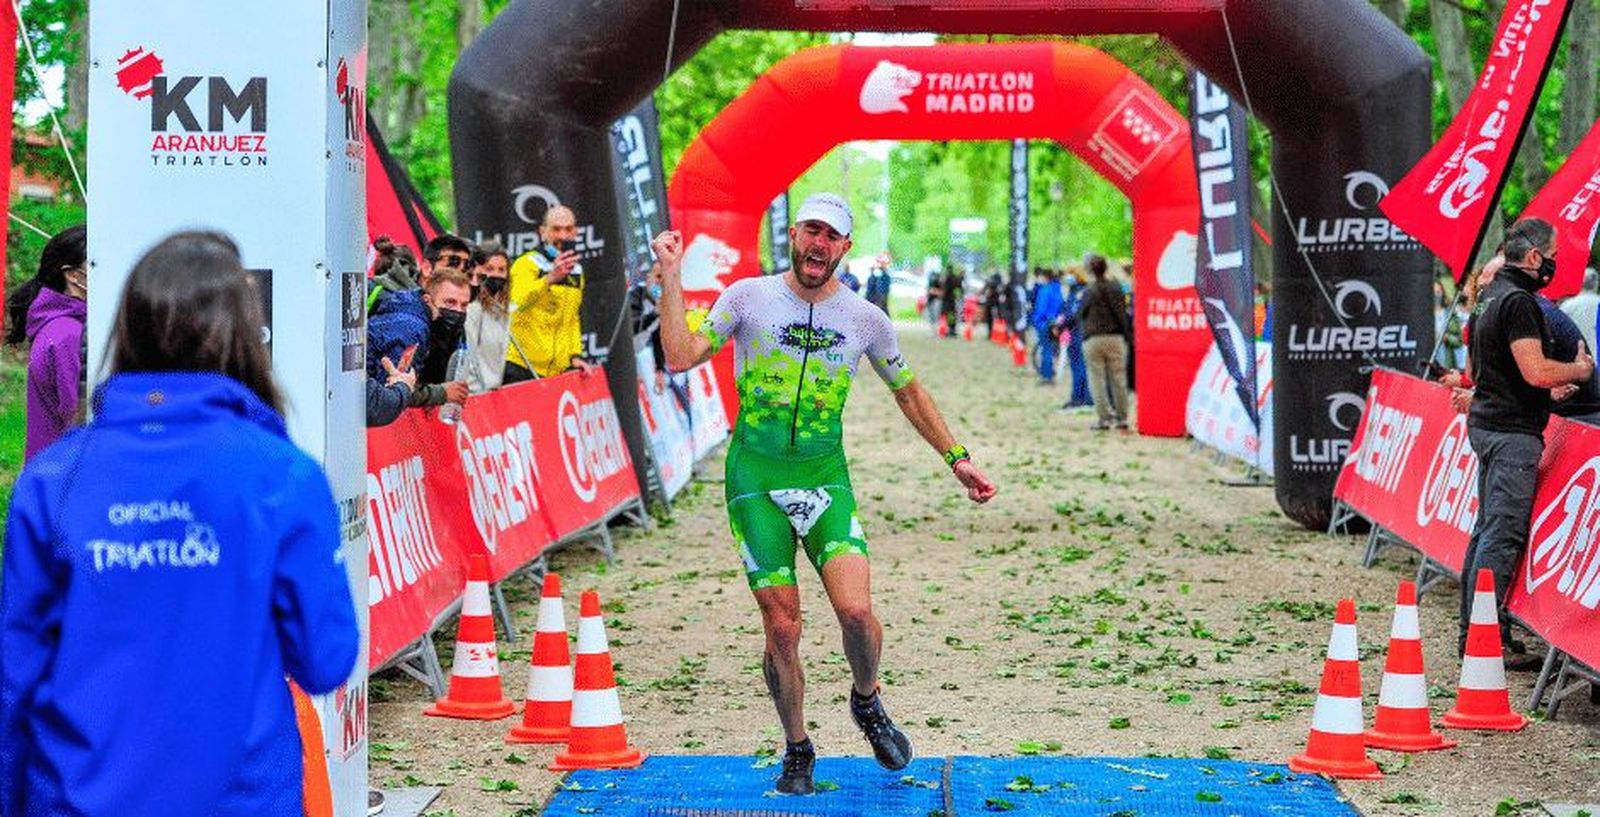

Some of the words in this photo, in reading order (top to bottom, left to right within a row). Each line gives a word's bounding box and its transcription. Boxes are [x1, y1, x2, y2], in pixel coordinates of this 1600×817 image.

[925, 72, 1034, 91] TRIATLON
[151, 76, 267, 132] KM
[925, 93, 1035, 113] MADRID
[151, 135, 267, 152] ARANJUEZ
[151, 153, 267, 166] TRIATLÓN
[1297, 217, 1418, 244] LURBE
[1147, 313, 1209, 331] MADR
[1288, 324, 1417, 351] LURBEL
[108, 500, 195, 526] OFICIAL
